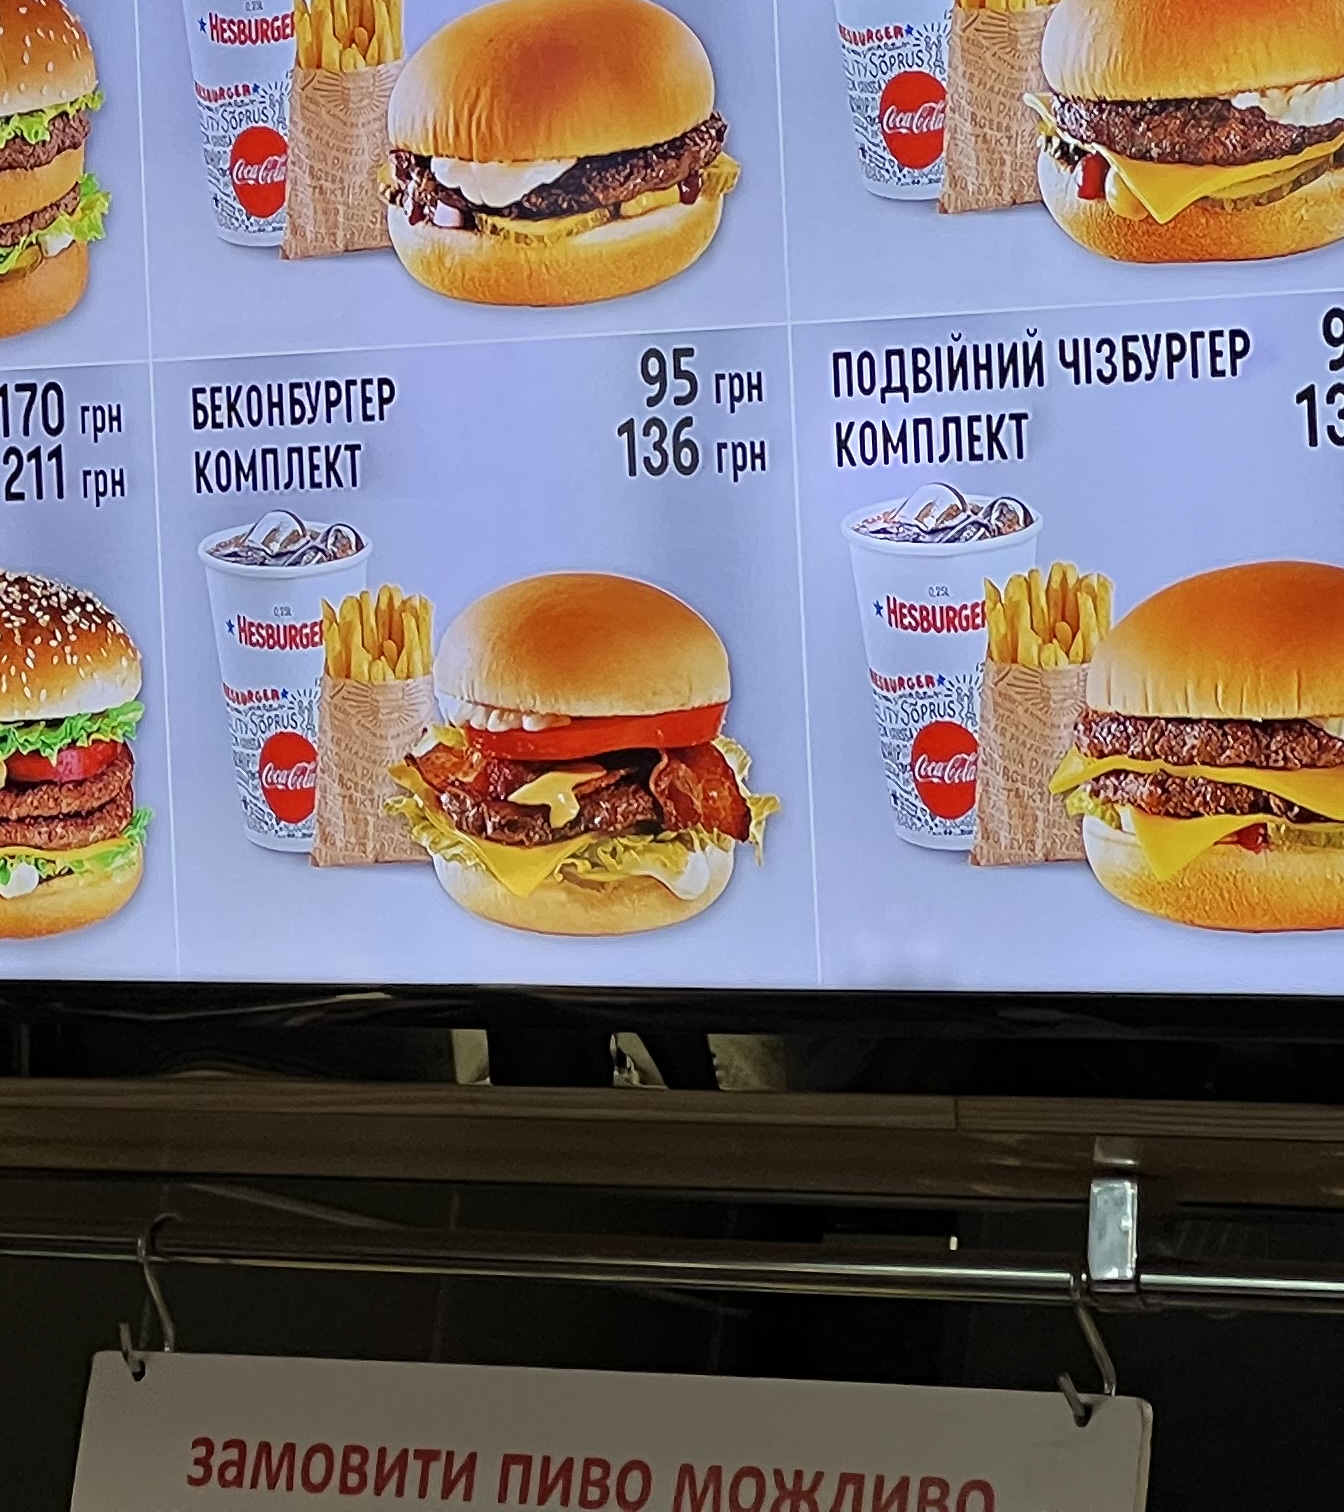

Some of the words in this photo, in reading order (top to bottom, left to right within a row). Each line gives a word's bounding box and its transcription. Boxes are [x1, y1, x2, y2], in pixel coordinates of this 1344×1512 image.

[640, 347, 699, 408] 95
[714, 371, 763, 414] грн
[832, 328, 1045, 405] ПОДВІЙНИЙ
[1058, 328, 1251, 386] ЧІЗБУРГЕР
[80, 403, 122, 444] грн
[191, 377, 396, 430] БЕКОНБУРГЕР
[194, 443, 362, 494] КОМПЛЕКТ
[617, 415, 700, 477] 136
[716, 440, 766, 483] грн
[835, 412, 1029, 468] КОМПЛЕКТ
[2, 443, 65, 502] 211
[82, 467, 125, 508] грн
